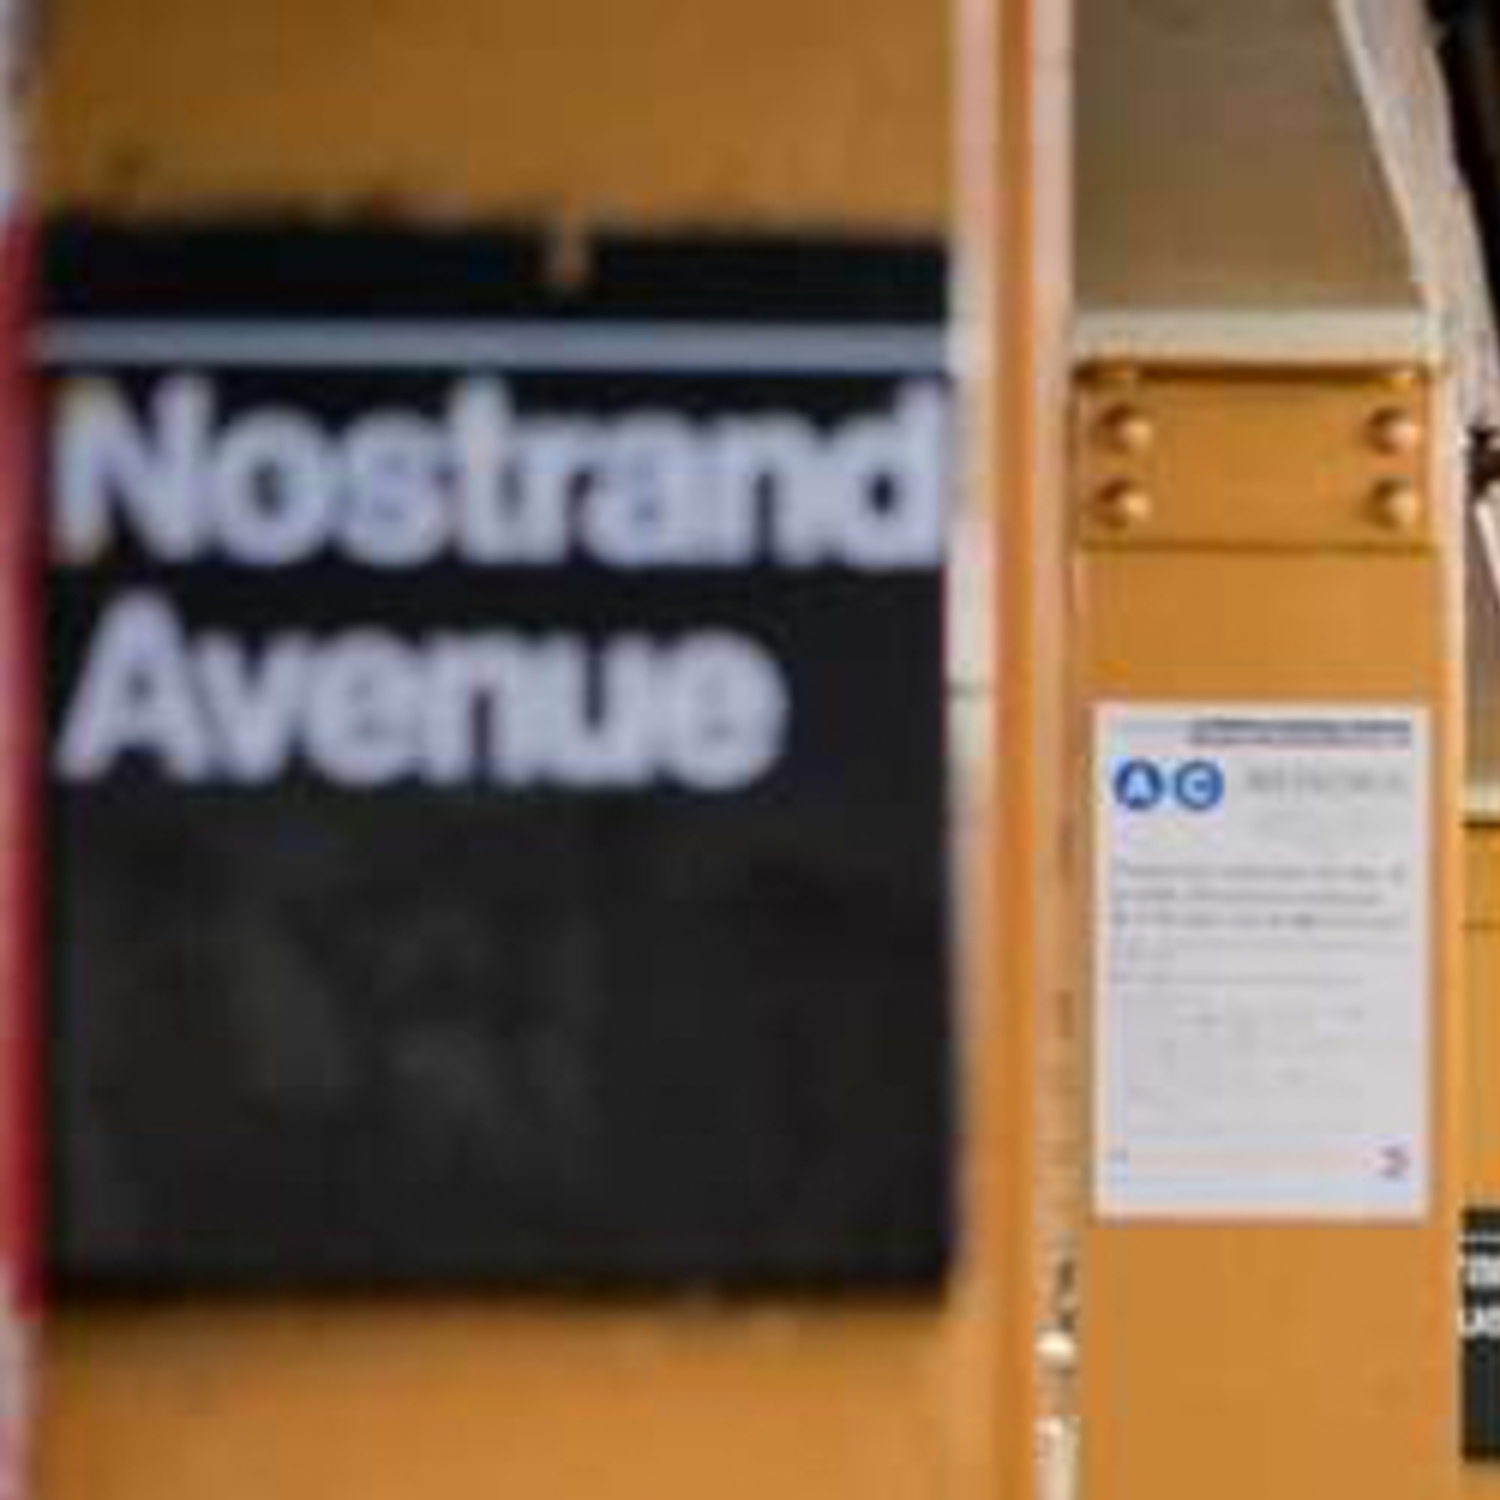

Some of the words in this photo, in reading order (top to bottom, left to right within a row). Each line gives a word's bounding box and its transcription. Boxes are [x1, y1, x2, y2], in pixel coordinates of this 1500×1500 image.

[50, 373, 946, 568] Nostrand
[56, 589, 790, 790] Avenue
[1121, 762, 1156, 804] A
[1176, 763, 1214, 807] C
